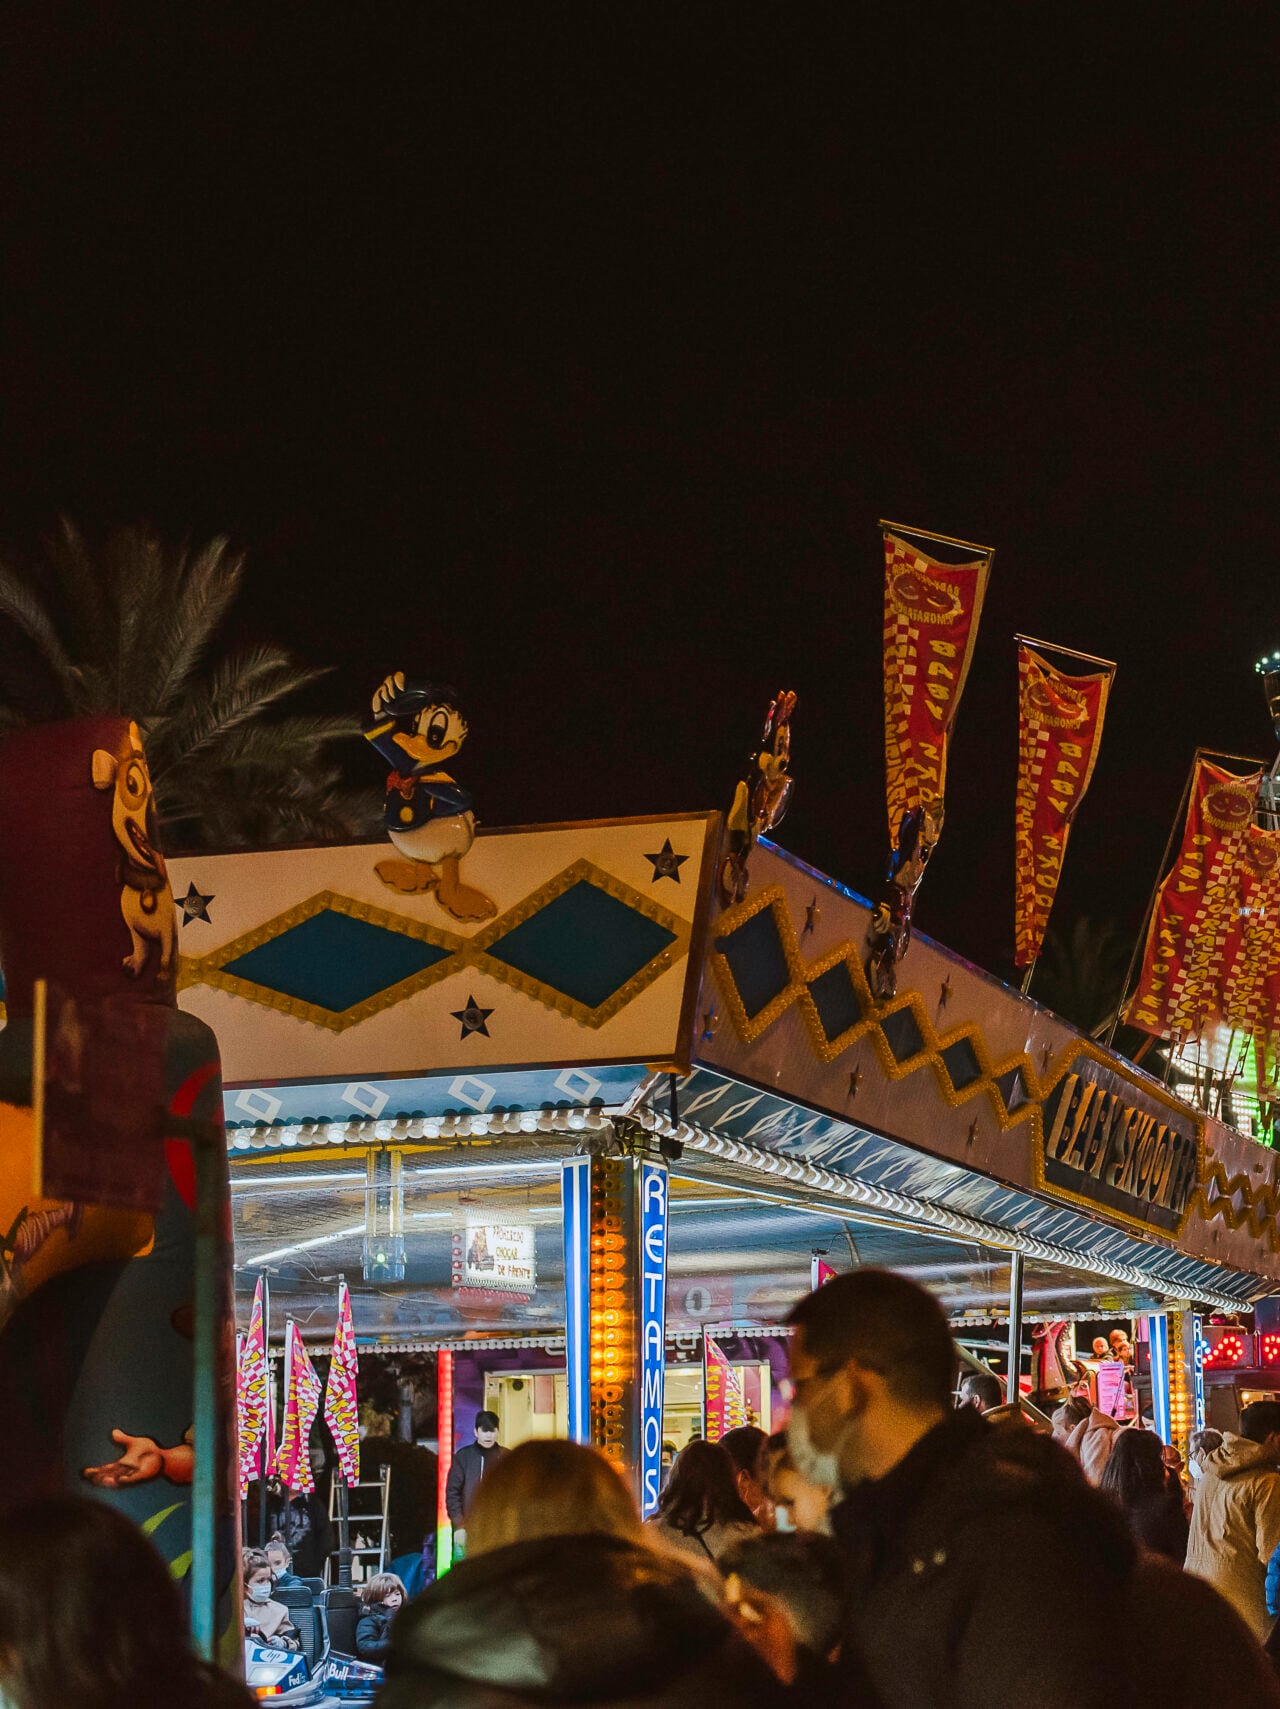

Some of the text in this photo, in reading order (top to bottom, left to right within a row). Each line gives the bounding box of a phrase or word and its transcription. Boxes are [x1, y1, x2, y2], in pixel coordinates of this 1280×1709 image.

[1134, 913, 1184, 1026] SKOOTER
[1046, 1073, 1124, 1180] BABY
[642, 1174, 667, 1511] RETAMOS
[329, 1662, 350, 1680] Bull
